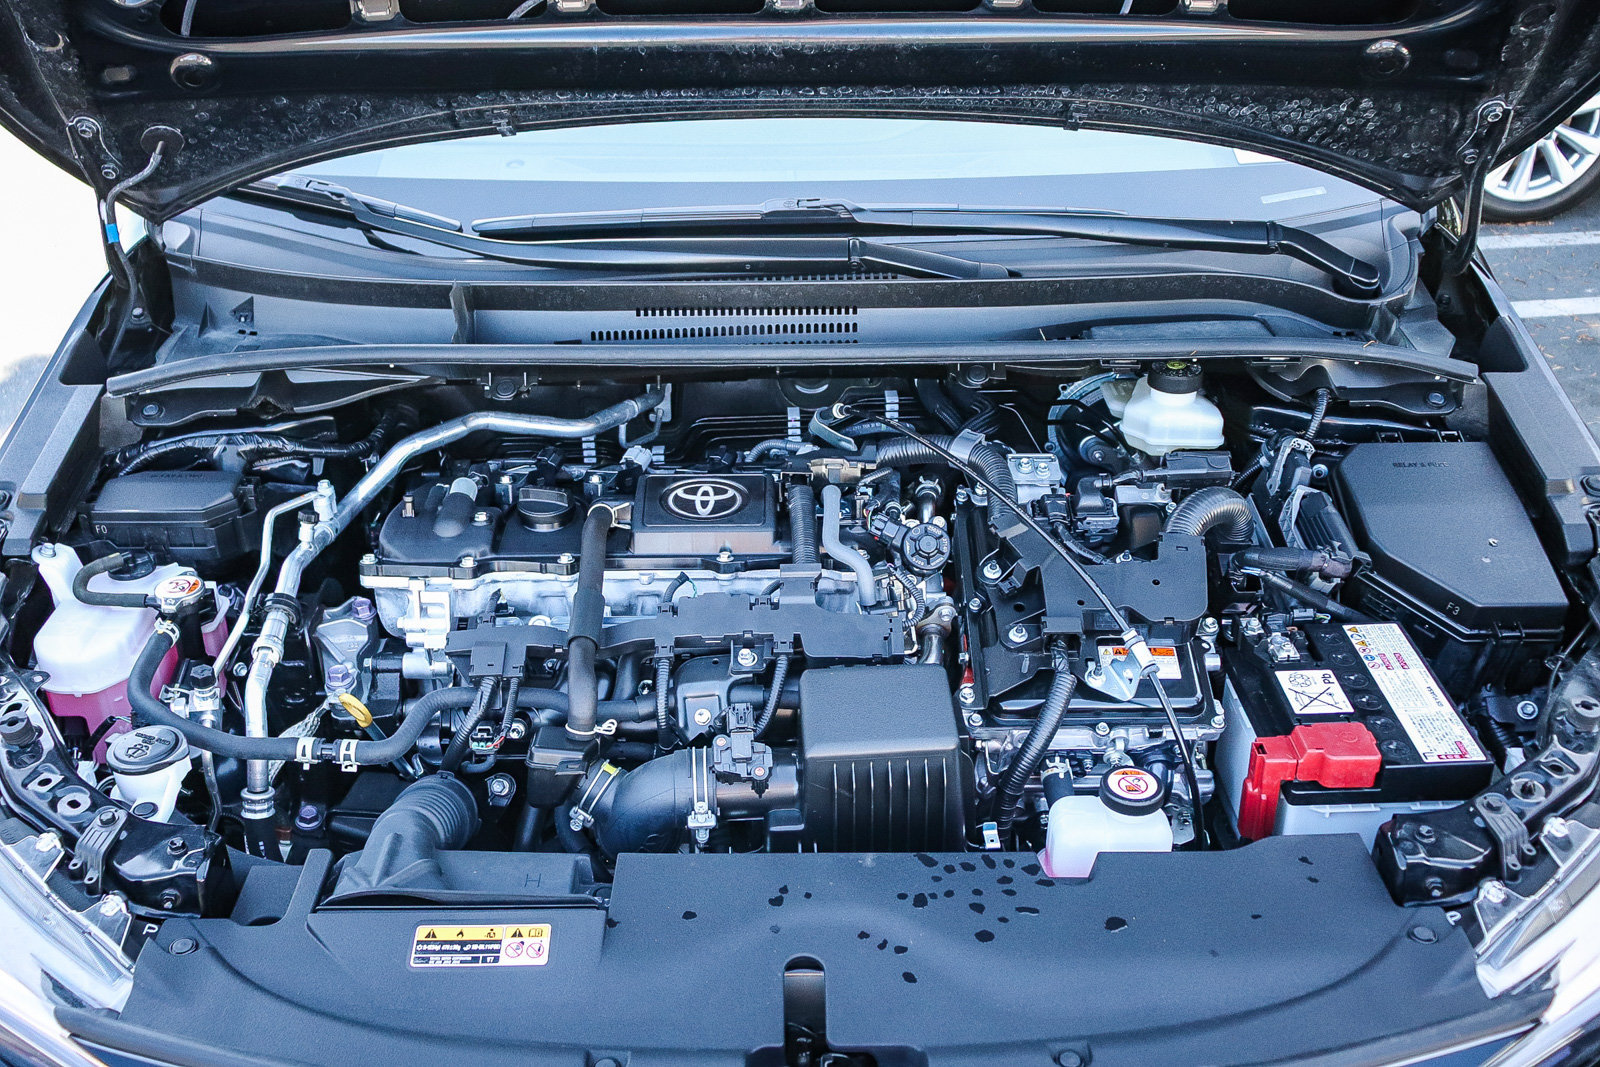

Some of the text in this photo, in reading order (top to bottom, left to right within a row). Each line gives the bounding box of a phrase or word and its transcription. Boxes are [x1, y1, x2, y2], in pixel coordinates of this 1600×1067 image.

[1446, 601, 1460, 616] F3
[1321, 673, 1335, 684] Pb
[524, 873, 541, 888] H
[142, 923, 158, 935] P
